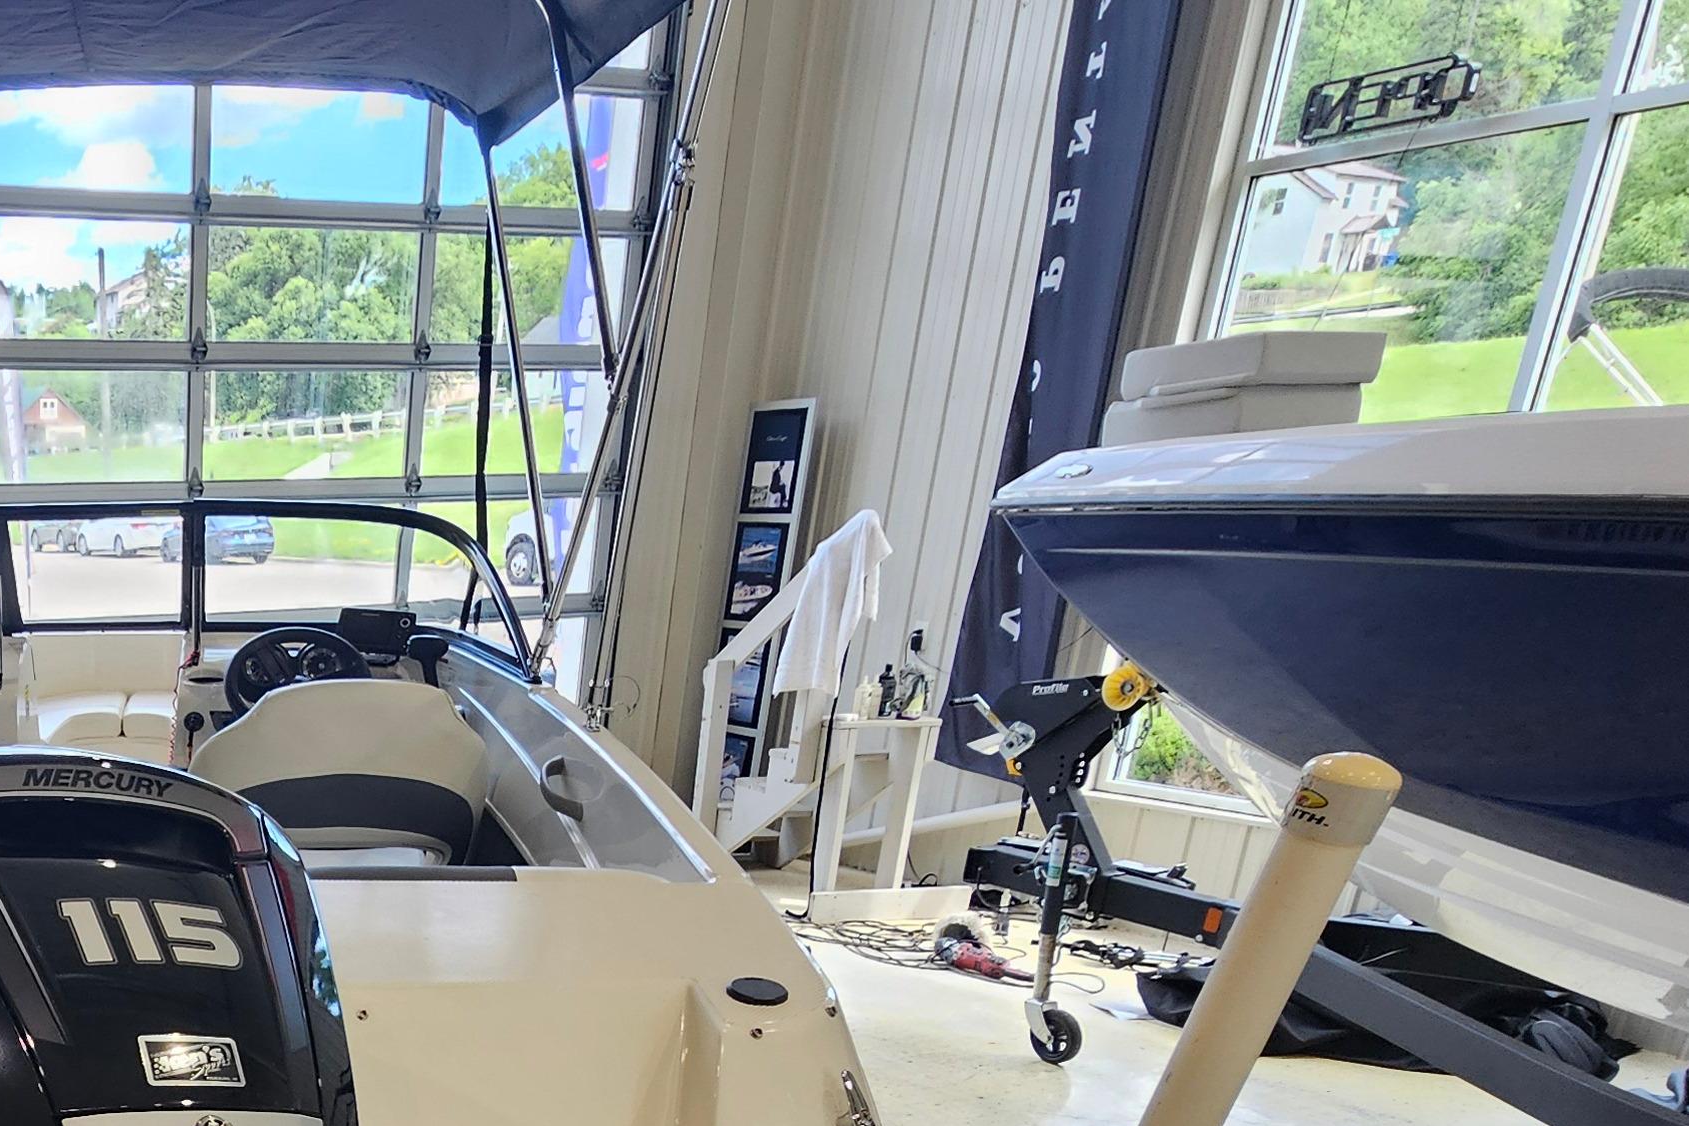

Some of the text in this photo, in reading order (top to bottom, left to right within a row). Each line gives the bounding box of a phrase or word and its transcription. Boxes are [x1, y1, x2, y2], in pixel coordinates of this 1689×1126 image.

[22, 768, 173, 798] MERCURY
[1292, 808, 1326, 826] ITH
[56, 898, 243, 971] 115
